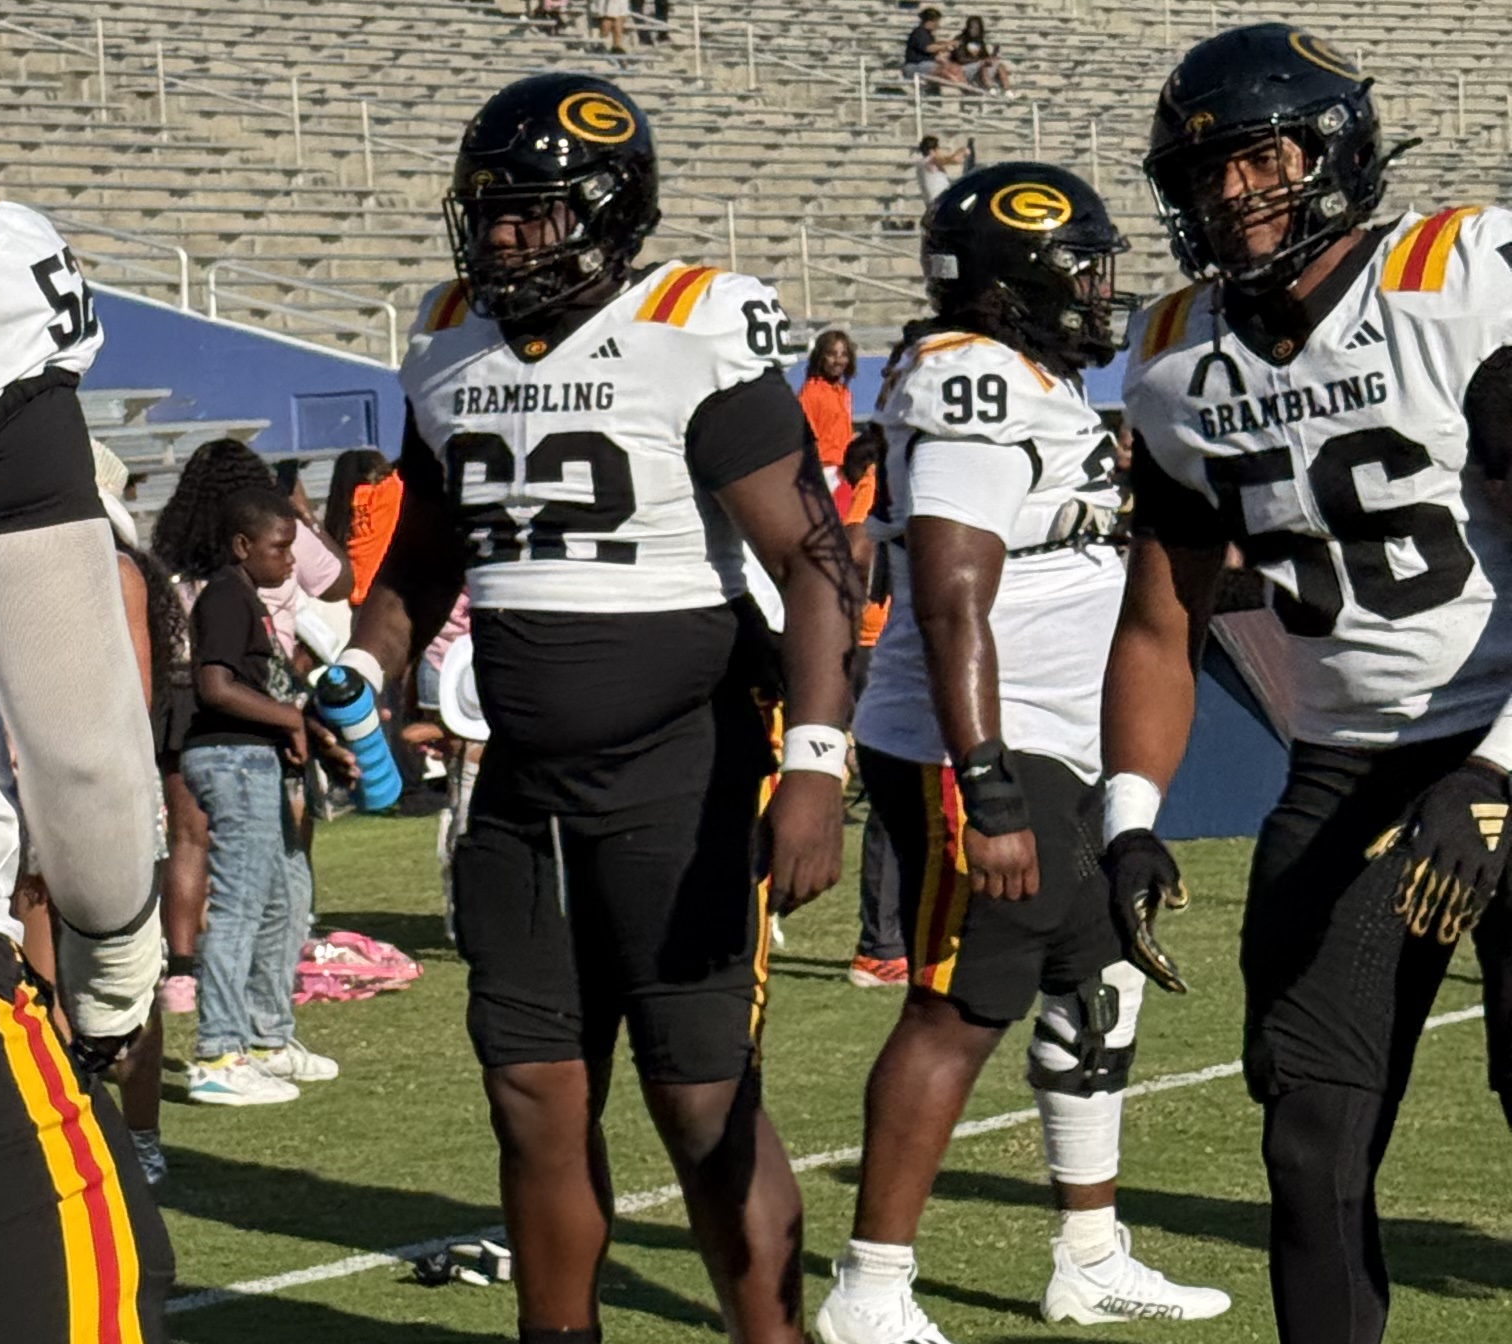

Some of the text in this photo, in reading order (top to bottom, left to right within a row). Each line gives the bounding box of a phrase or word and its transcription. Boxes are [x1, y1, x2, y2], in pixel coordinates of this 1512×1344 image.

[454, 382, 615, 416] GRAMBLING
[941, 373, 1007, 425] 99
[1199, 371, 1387, 438] GRAMBLING
[445, 430, 638, 566] 62
[1204, 426, 1475, 638] 56
